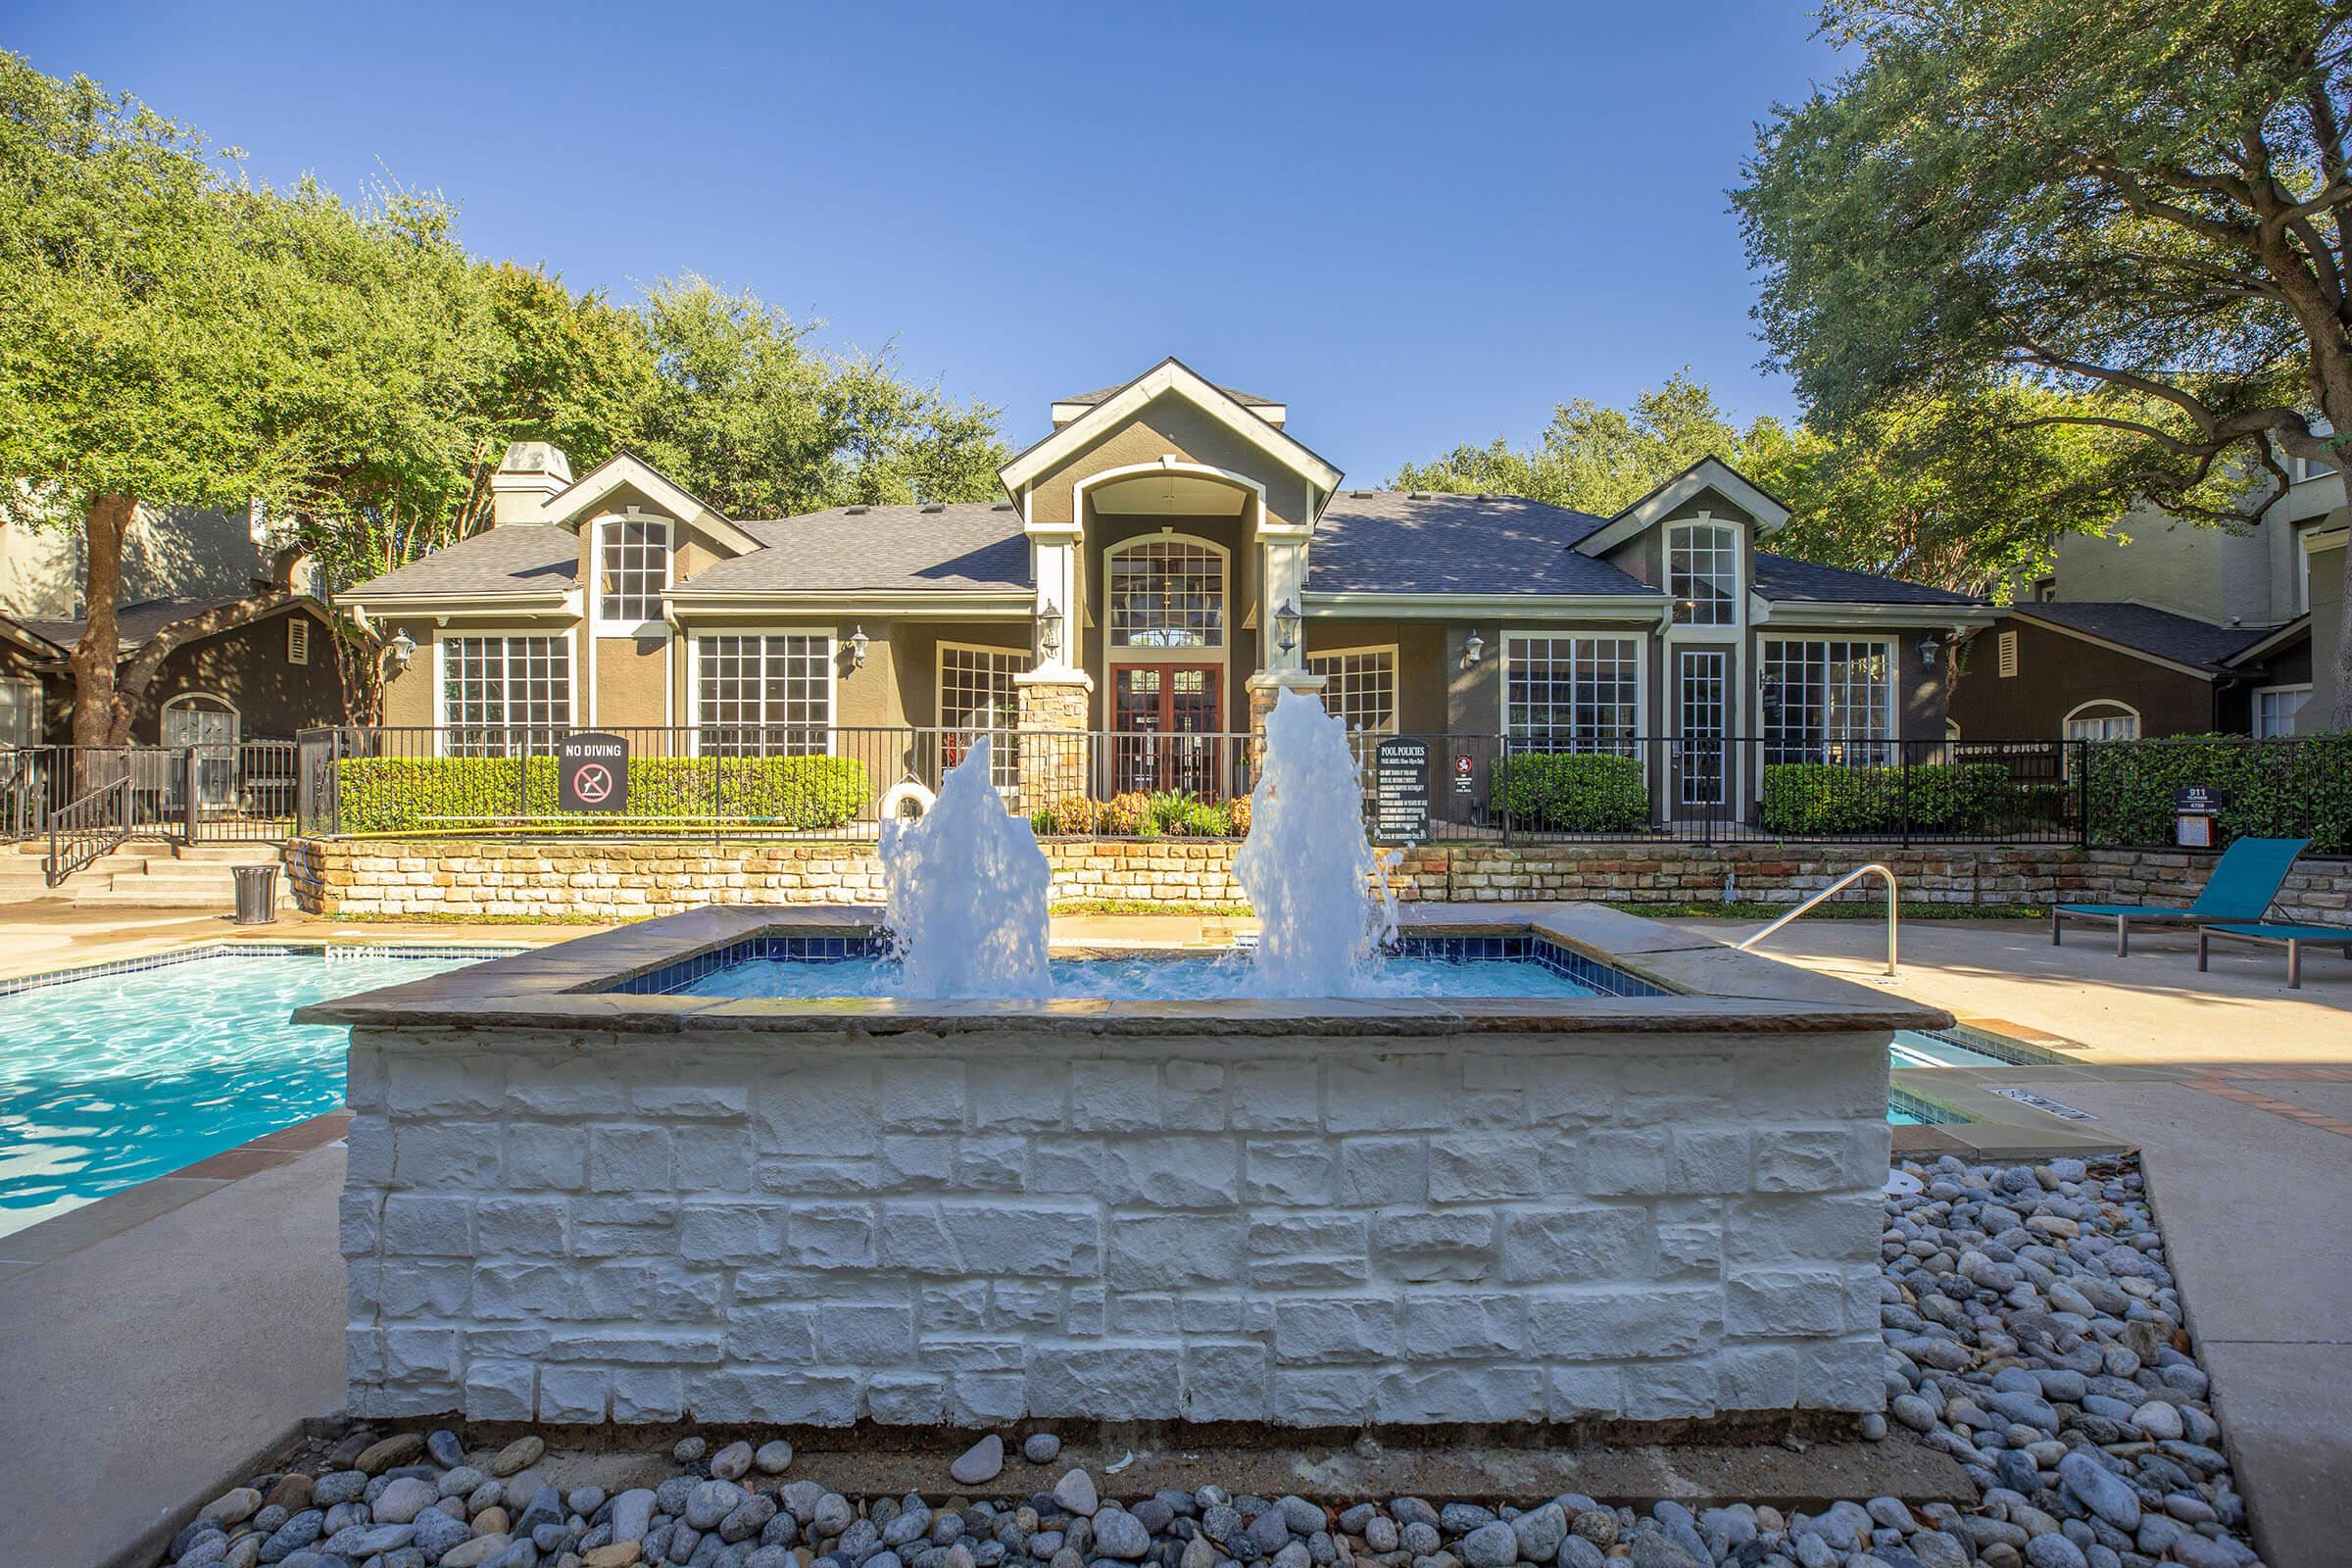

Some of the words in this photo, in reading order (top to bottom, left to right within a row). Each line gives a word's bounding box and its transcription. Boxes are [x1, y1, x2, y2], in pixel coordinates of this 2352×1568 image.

[565, 745, 582, 757] NO
[584, 745, 621, 757] DIVING
[1381, 746, 1397, 757] POOL
[1397, 746, 1425, 757] POLICIES
